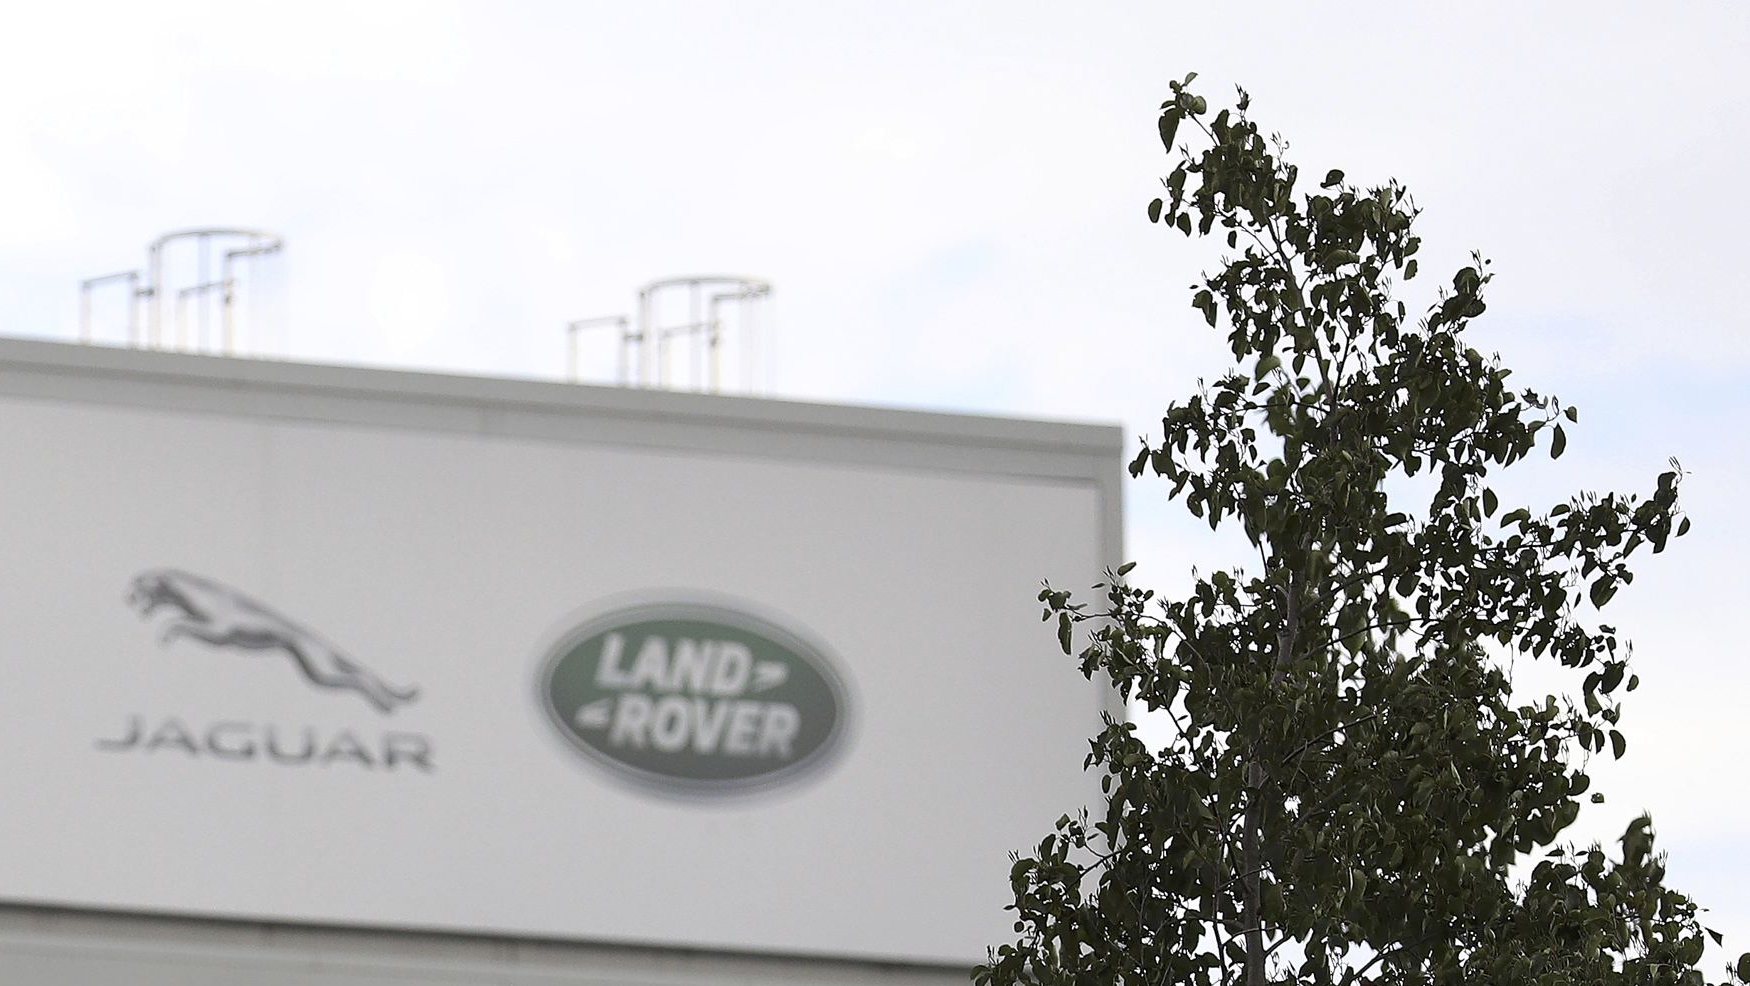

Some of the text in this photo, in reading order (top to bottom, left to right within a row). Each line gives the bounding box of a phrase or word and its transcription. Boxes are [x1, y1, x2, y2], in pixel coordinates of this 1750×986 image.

[595, 633, 752, 696] LAND
[95, 715, 437, 773] JAGUAR
[608, 694, 801, 757] ROVER
